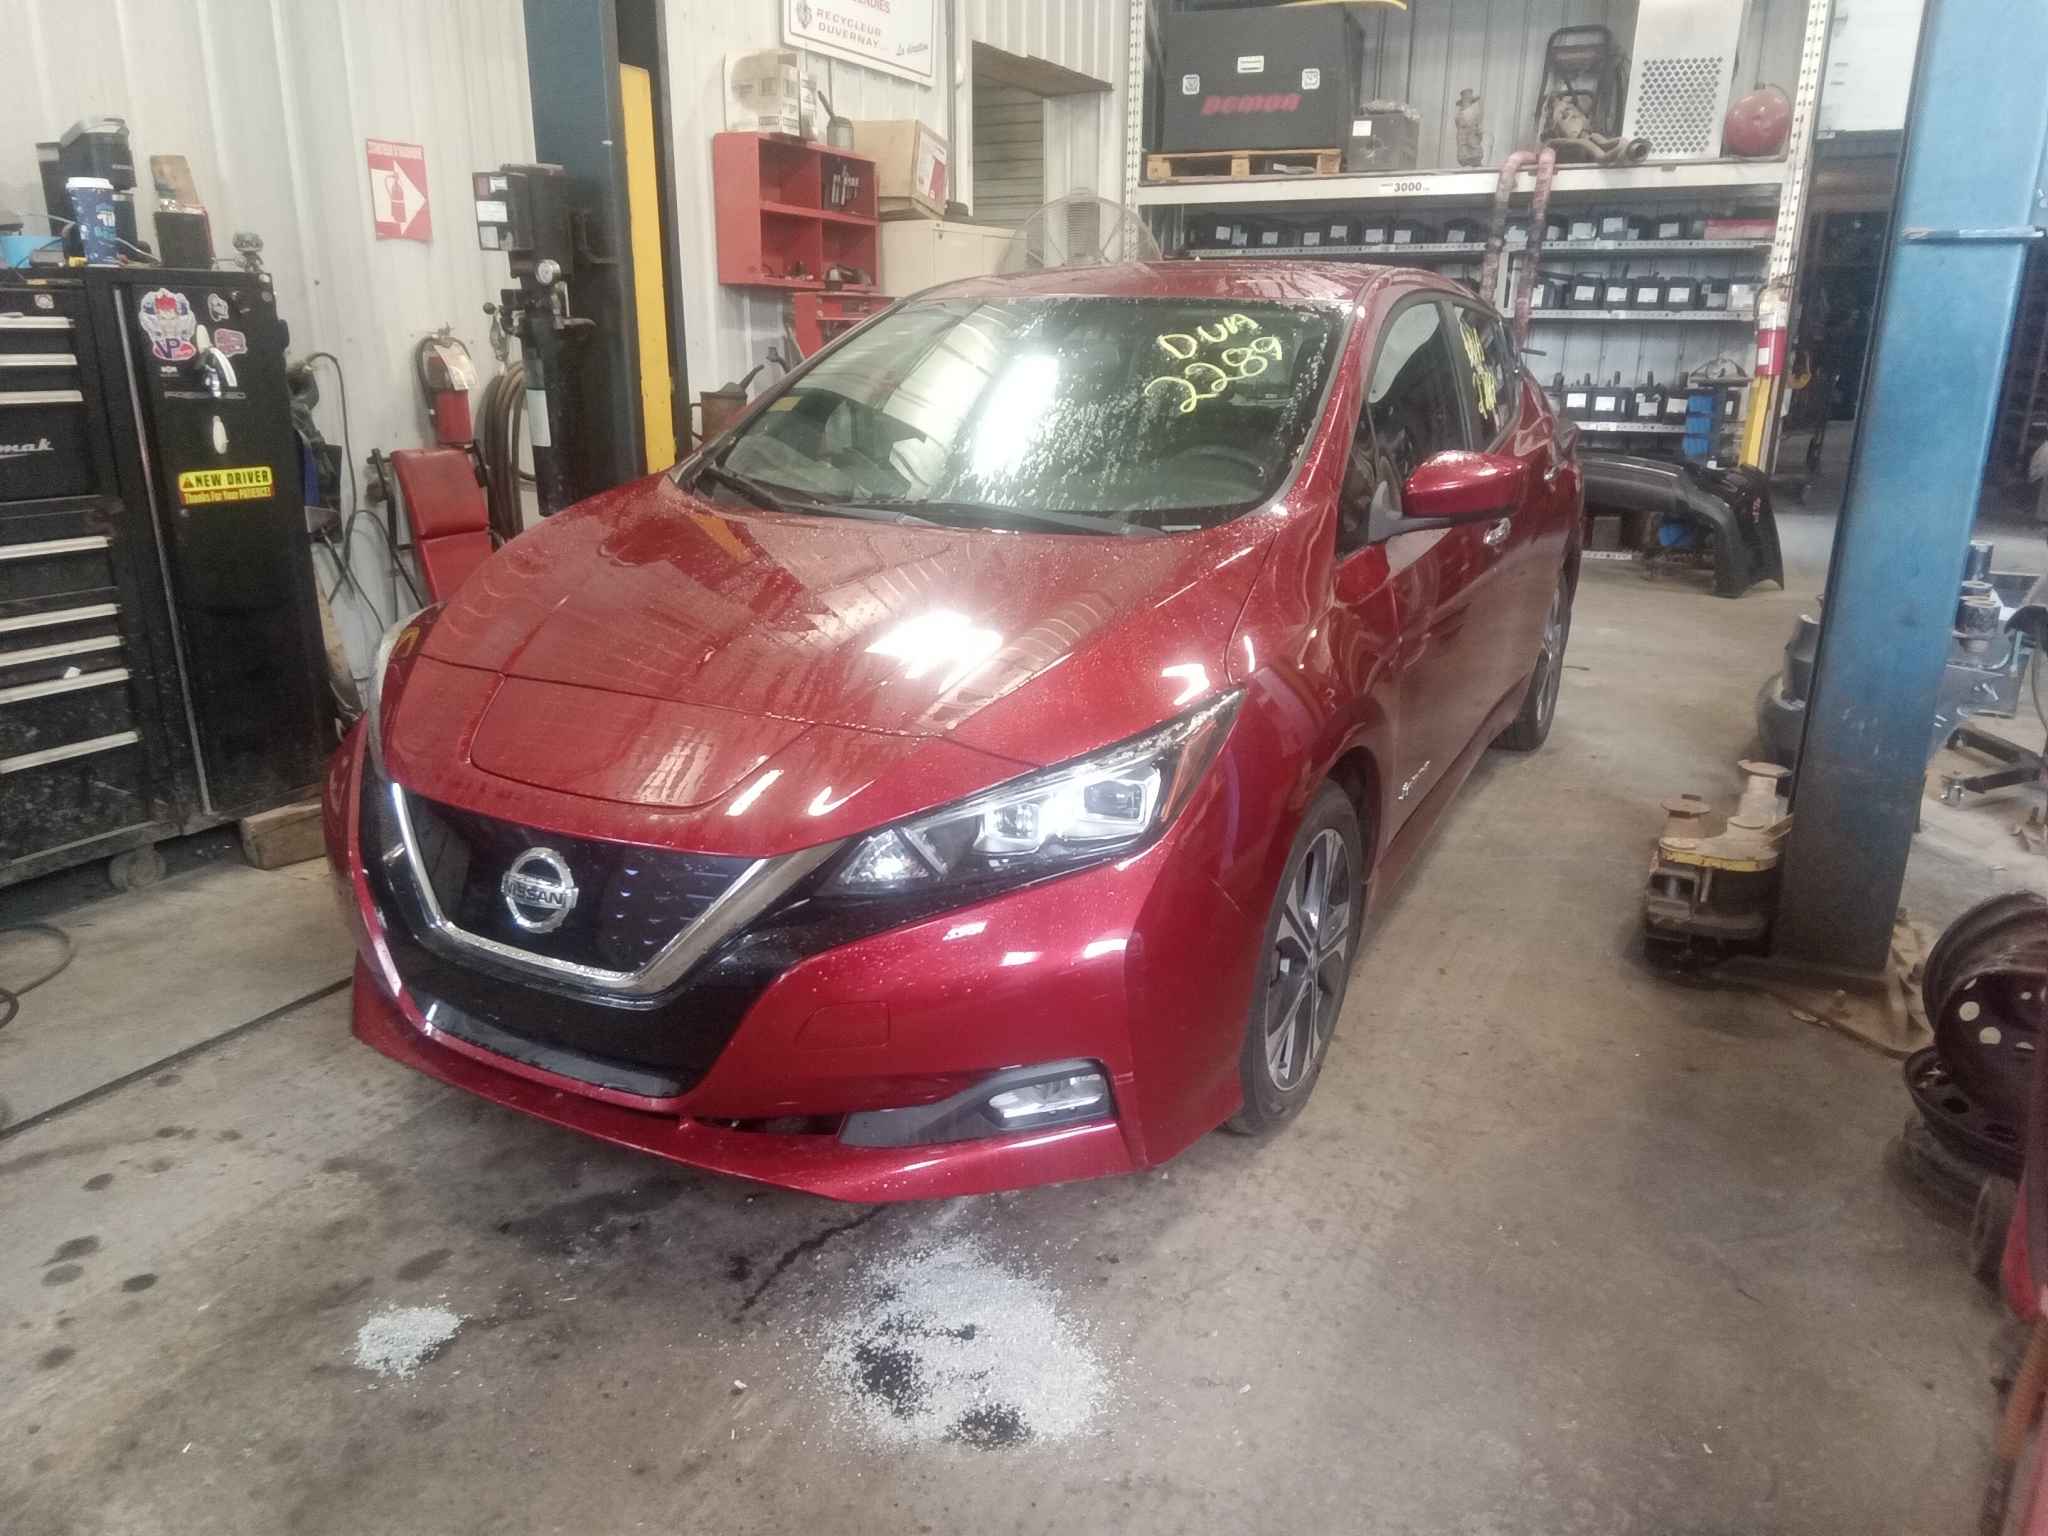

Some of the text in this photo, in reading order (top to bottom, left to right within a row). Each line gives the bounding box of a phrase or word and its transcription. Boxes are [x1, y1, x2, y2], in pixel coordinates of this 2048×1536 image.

[816, 8, 881, 36] RECYCLEUR
[818, 22, 880, 48] DUVERNAY
[1393, 182, 1423, 193] 3000
[194, 469, 269, 489] NEW DRIVER
[504, 878, 564, 906] NISSAN
